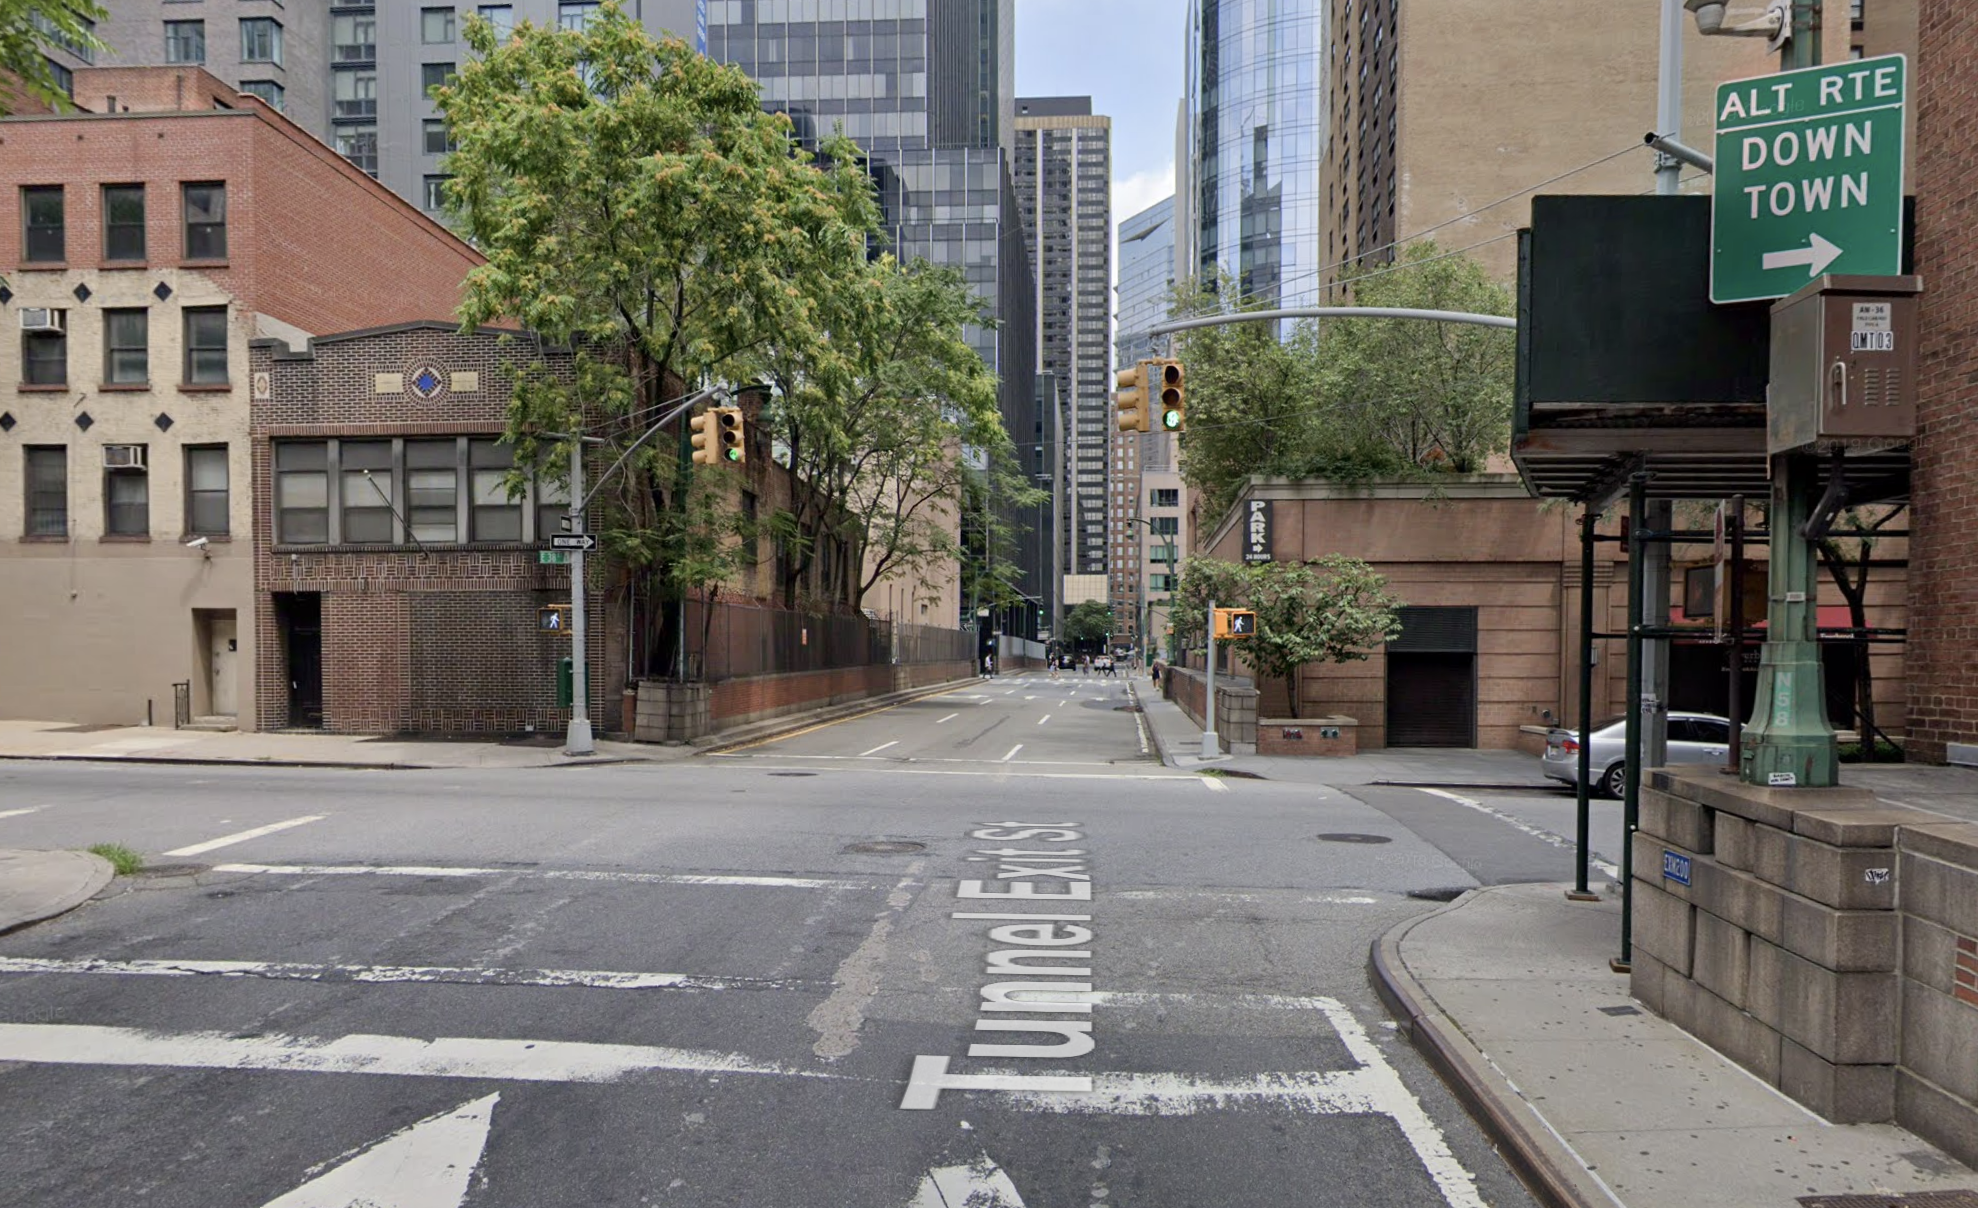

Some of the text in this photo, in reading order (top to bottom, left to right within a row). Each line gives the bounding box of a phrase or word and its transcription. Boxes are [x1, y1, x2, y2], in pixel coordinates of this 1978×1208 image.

[1719, 83, 1793, 122] ALT
[1820, 66, 1897, 106] RTE
[1741, 120, 1872, 171] DOWN
[1743, 172, 1869, 219] TOWN
[1250, 501, 1266, 543] PARK
